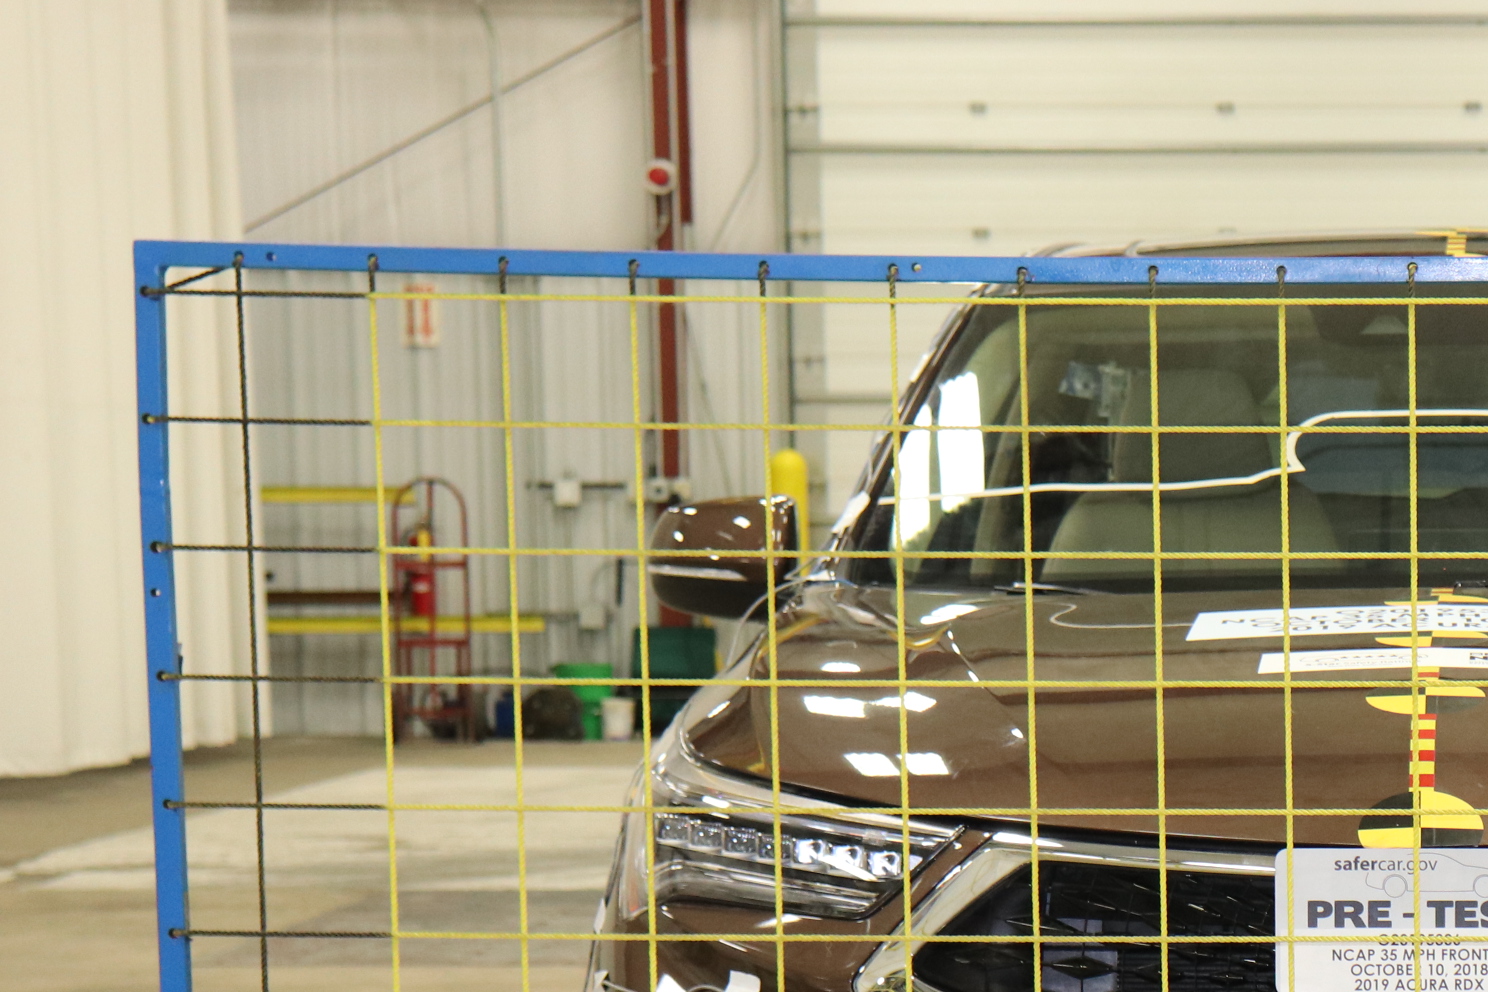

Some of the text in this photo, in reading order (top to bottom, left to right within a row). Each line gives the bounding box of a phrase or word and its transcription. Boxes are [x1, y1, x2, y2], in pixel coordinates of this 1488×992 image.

[1334, 856, 1438, 875] safercar.gov
[1307, 900, 1392, 929] PRE
[1332, 949, 1375, 961] NCAP
[1380, 949, 1397, 961] 35
[1350, 963, 1488, 977] OCTOBE 10, 2018
[1354, 978, 1484, 991] 2019 ACURA RDX
